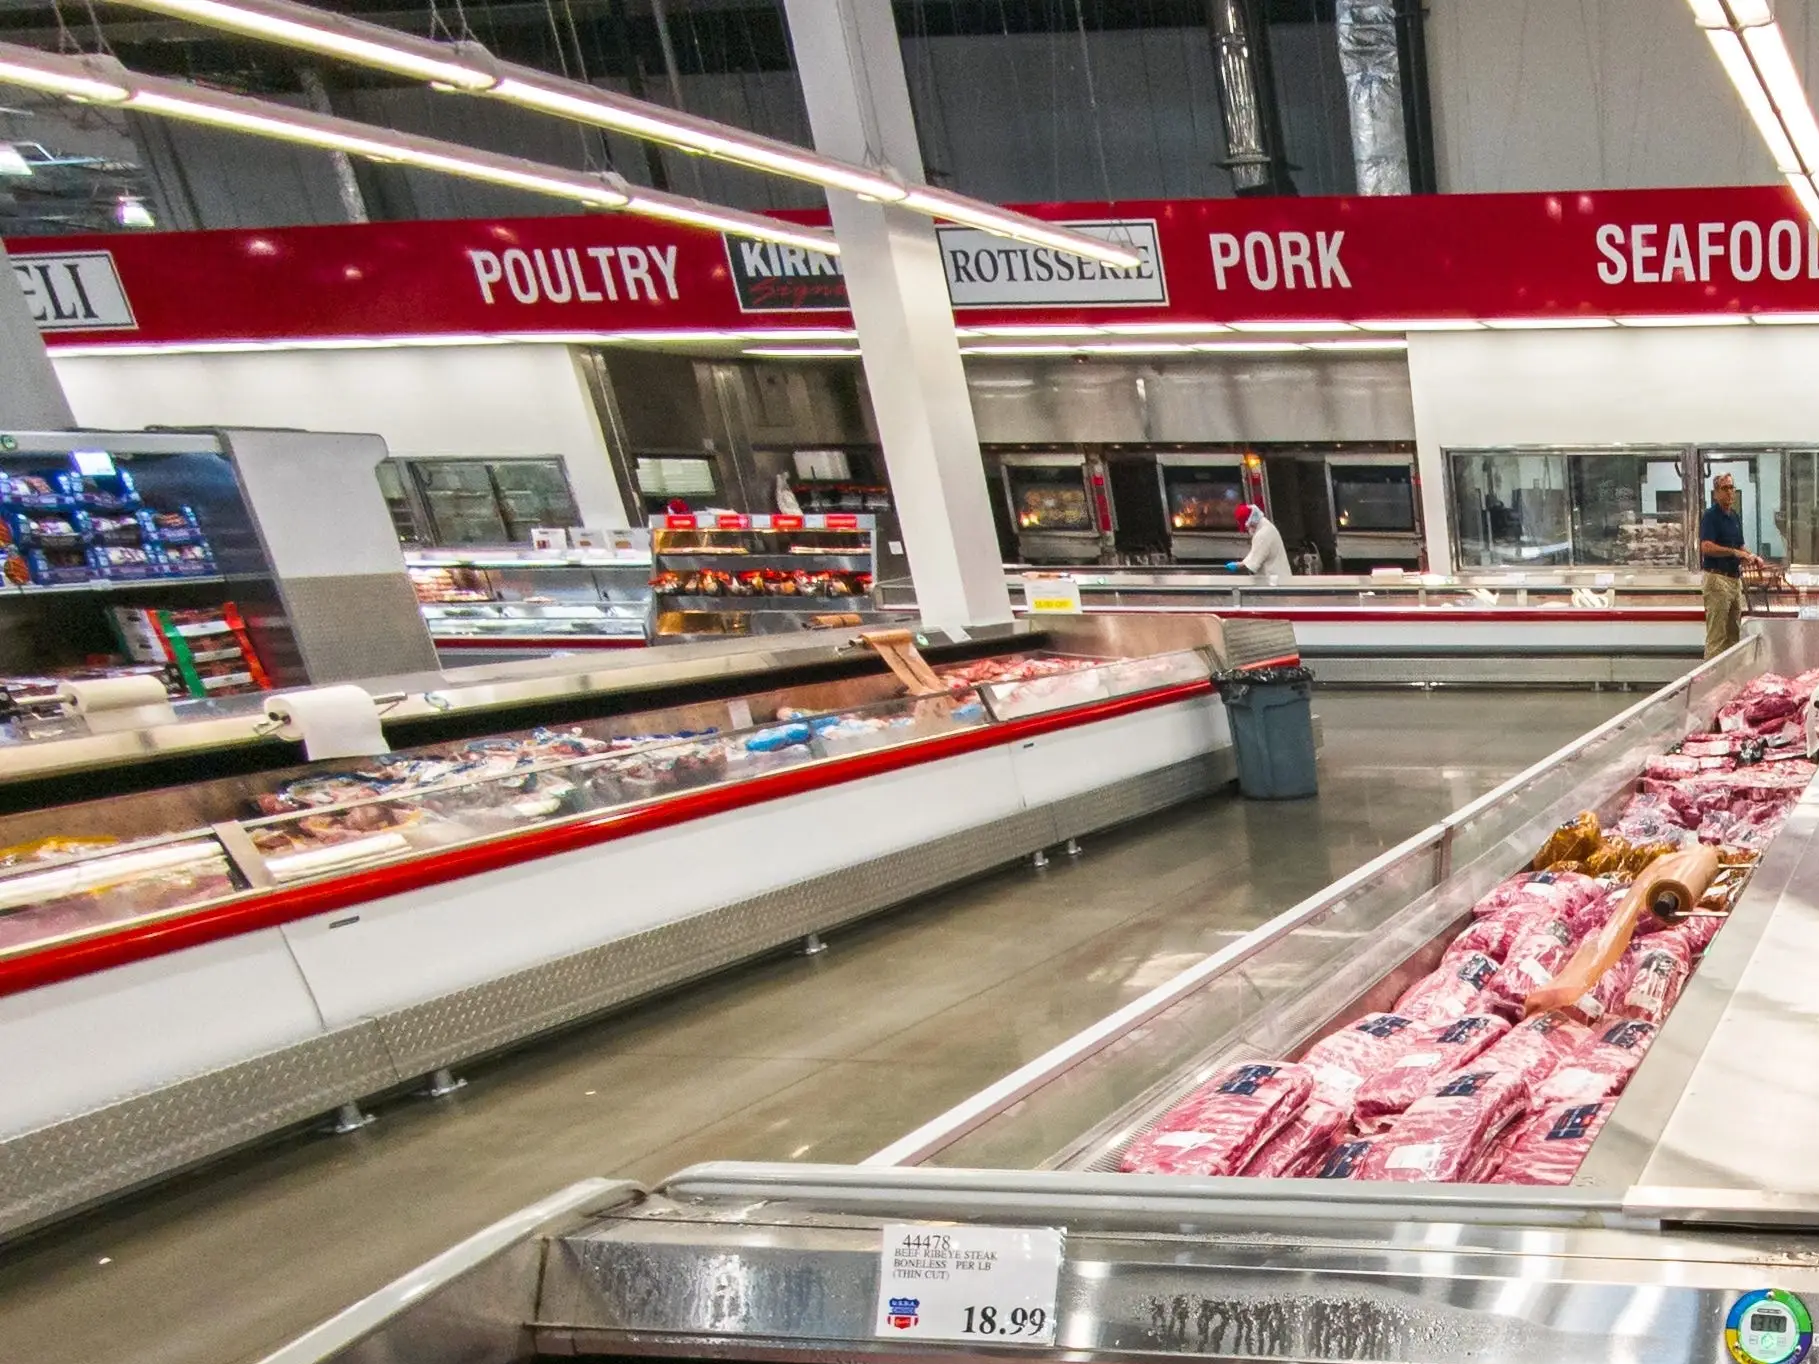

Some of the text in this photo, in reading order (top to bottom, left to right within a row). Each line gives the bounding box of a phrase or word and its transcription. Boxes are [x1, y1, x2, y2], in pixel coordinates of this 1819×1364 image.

[740, 241, 843, 277] KIRK
[1209, 230, 1352, 290] PORK
[470, 245, 680, 304] POULTRY
[902, 1234, 951, 1250] 44478
[893, 1258, 991, 1271] BONELESS PER LB
[894, 1248, 998, 1261] BEEF RIBEYE STEAK
[892, 1269, 950, 1281] (THIN CUT)
[962, 1305, 1047, 1336] 18.99
